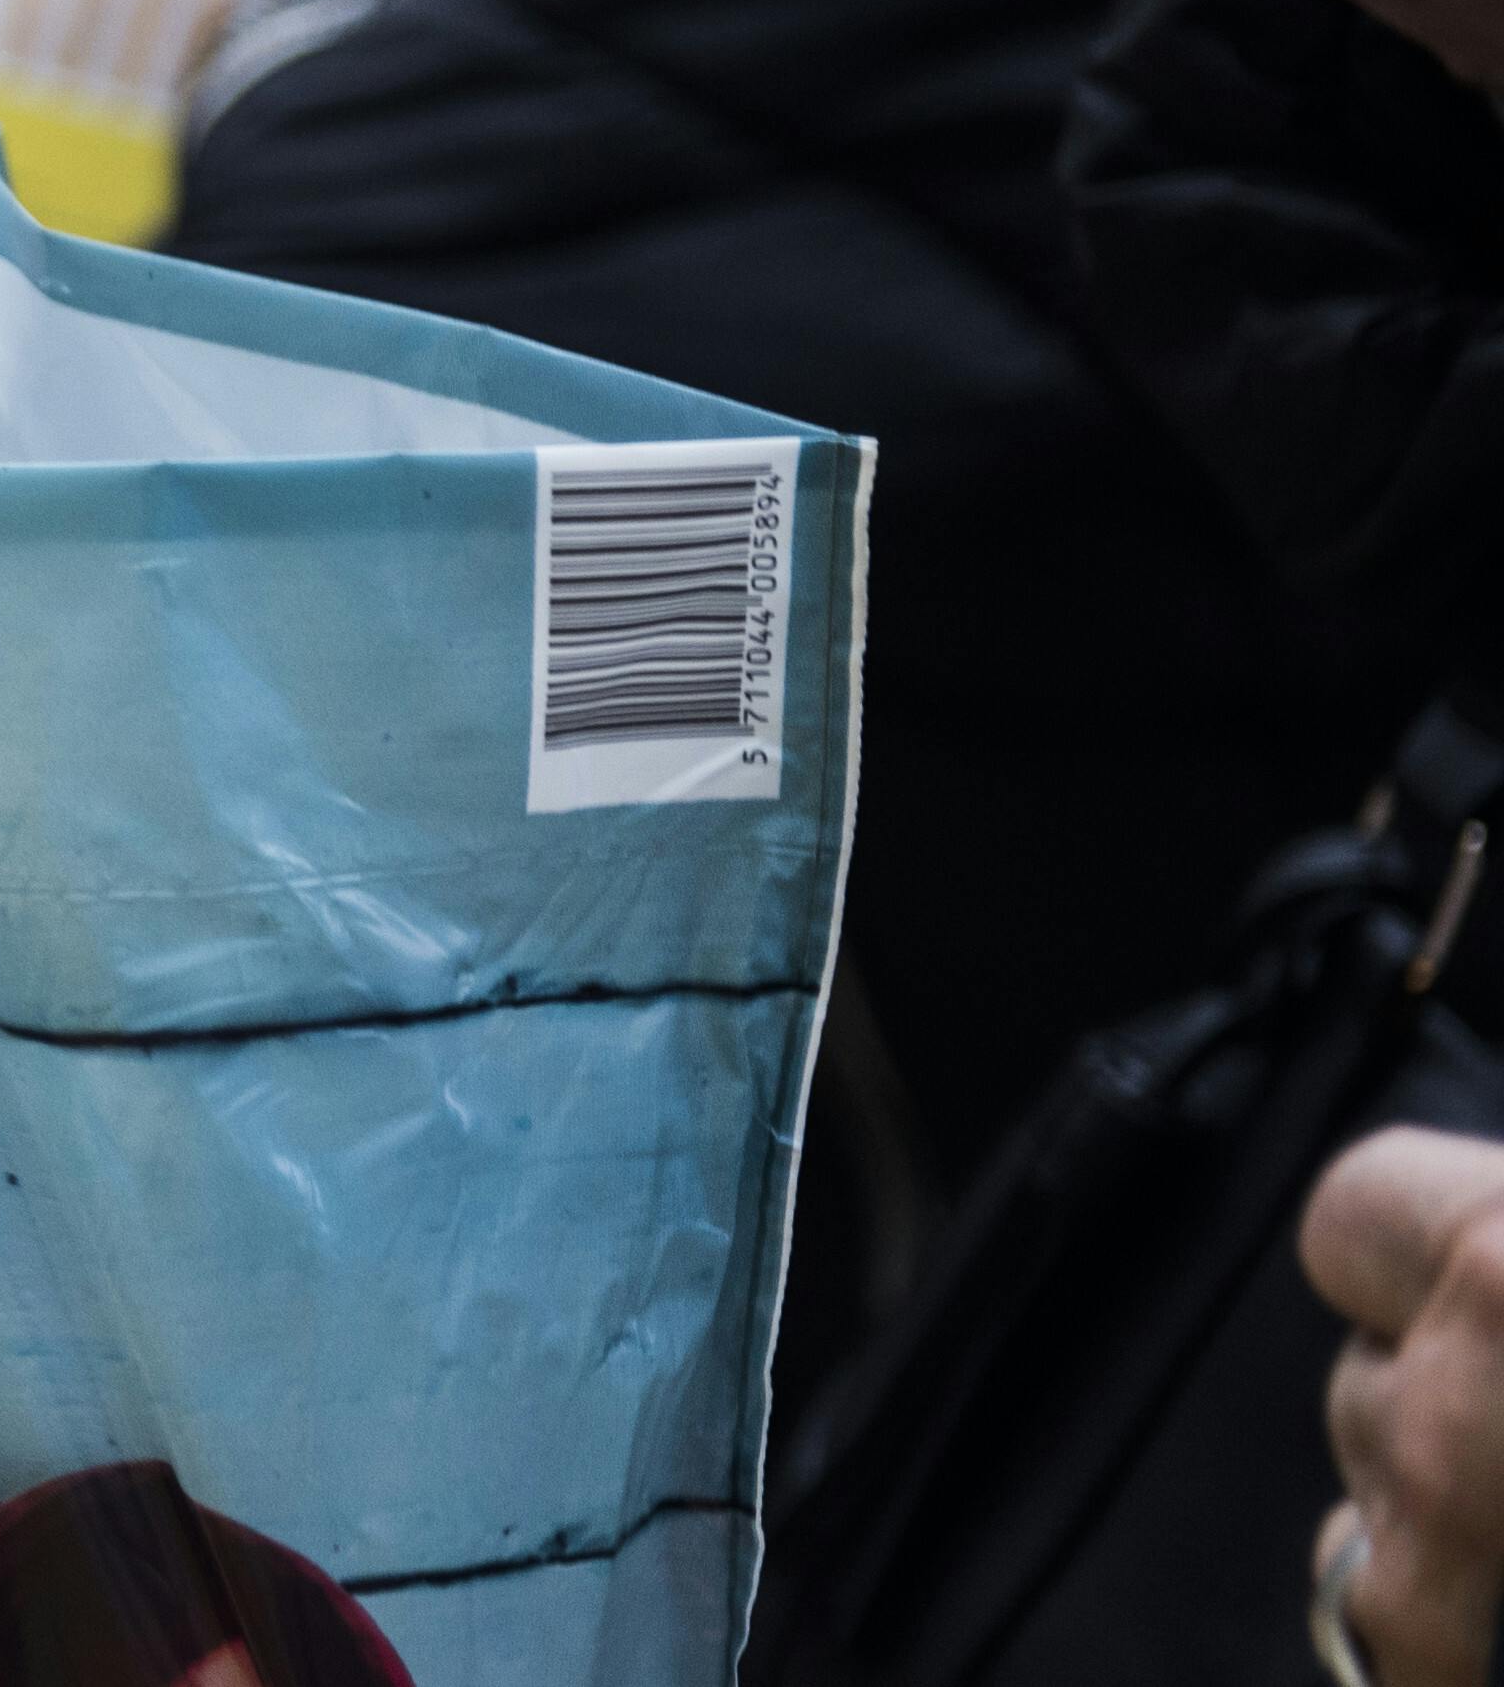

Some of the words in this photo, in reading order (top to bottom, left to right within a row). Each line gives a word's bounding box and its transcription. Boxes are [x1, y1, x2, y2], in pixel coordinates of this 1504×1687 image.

[751, 474, 784, 593] 005894
[744, 609, 775, 726] 711044
[742, 748, 768, 765] 5
